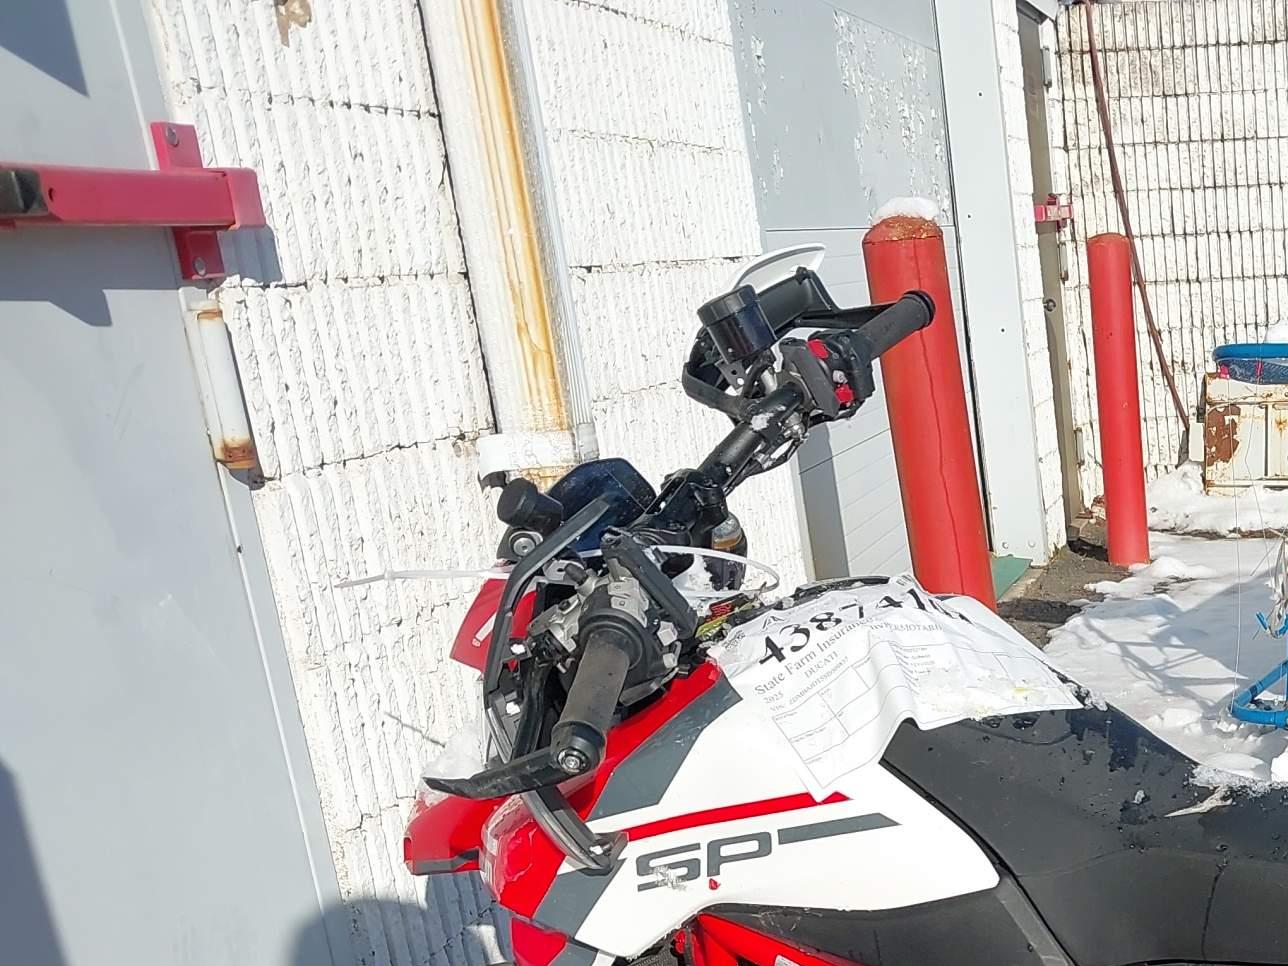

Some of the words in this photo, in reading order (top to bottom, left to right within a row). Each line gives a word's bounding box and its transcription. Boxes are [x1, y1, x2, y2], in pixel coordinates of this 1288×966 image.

[754, 672, 786, 695] State
[784, 650, 817, 675] Farm
[816, 617, 873, 652] Insurance
[804, 650, 839, 678] DUCATI
[636, 831, 773, 892] SP
